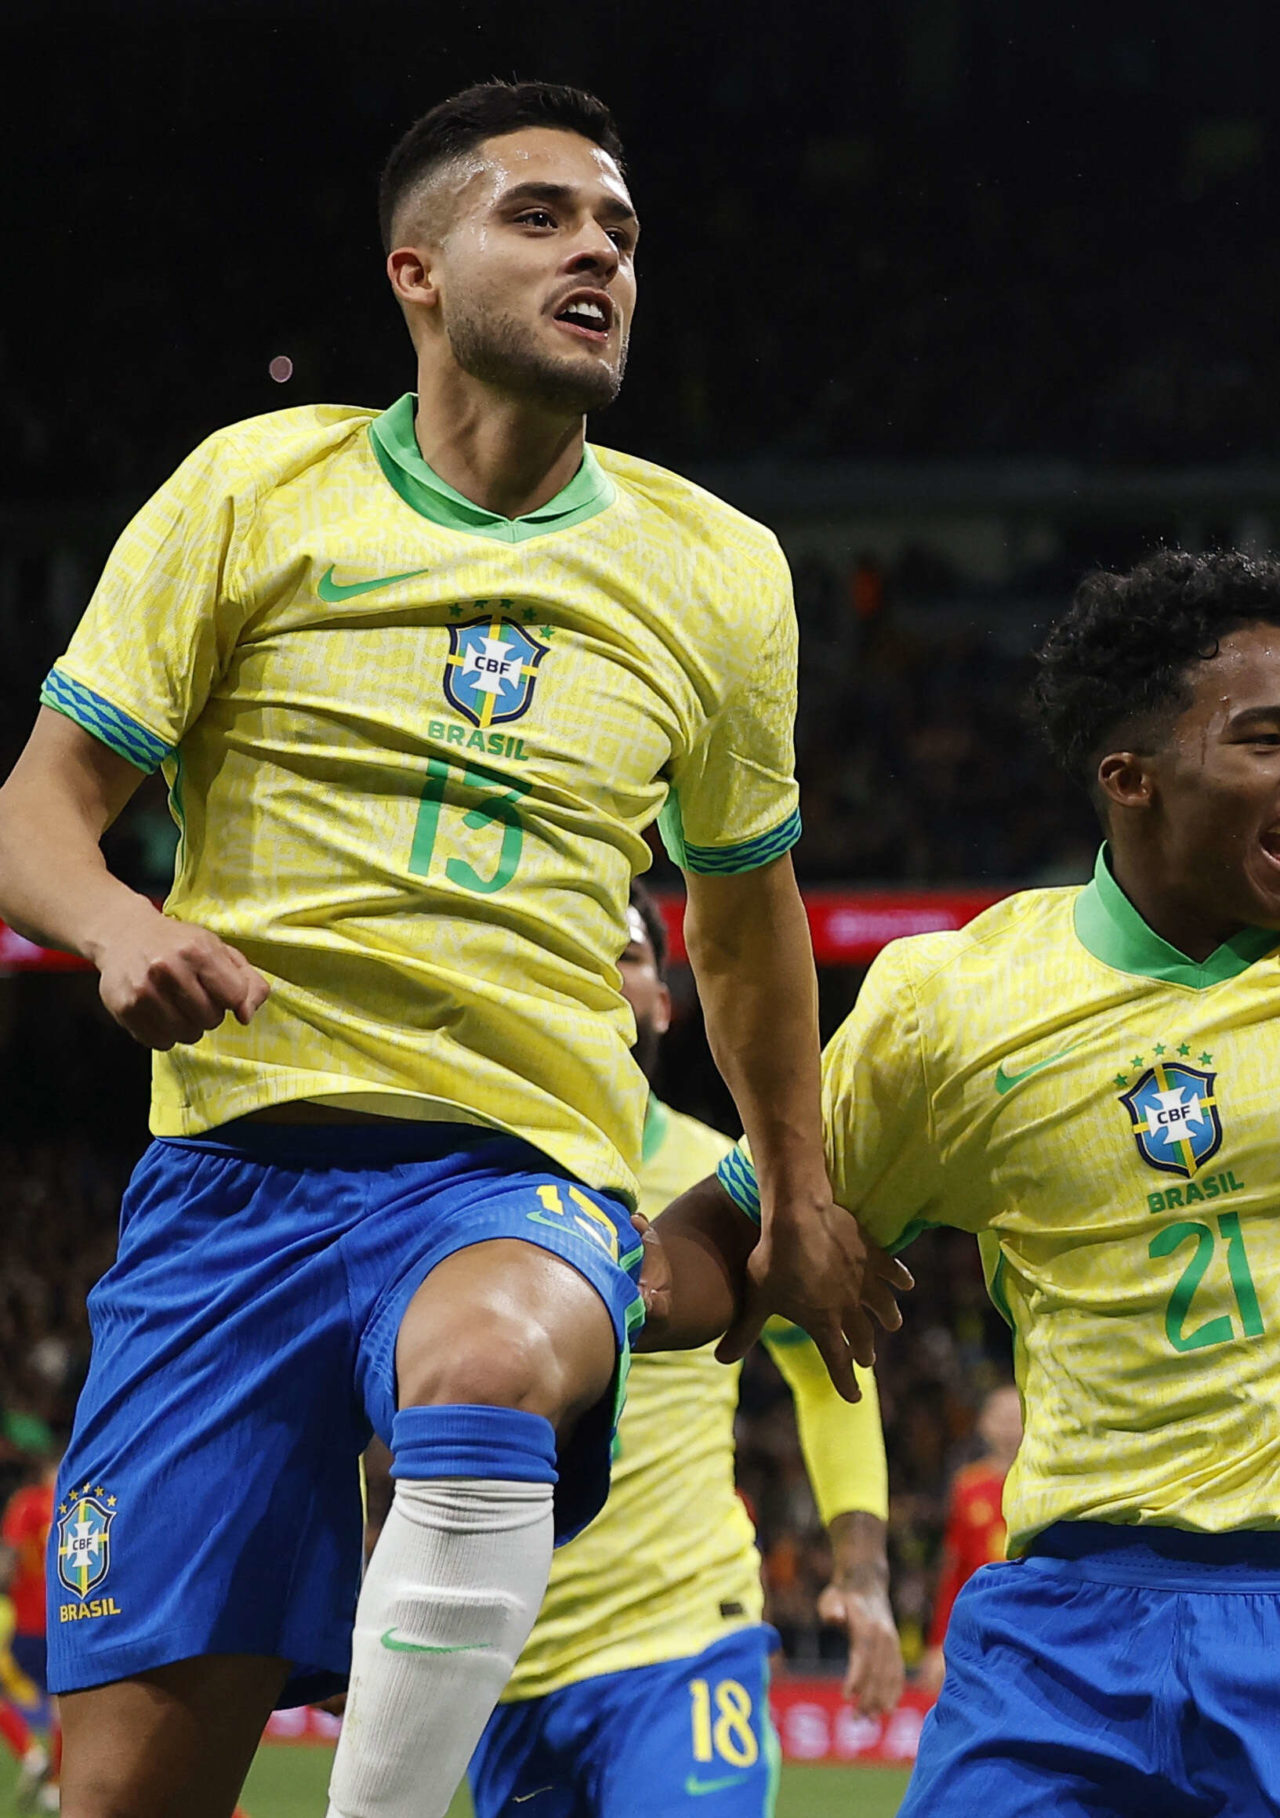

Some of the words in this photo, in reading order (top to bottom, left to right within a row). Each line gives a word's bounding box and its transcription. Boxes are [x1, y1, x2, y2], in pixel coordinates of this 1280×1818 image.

[474, 656, 512, 676] CBF
[428, 720, 530, 762] BRASIL
[408, 757, 533, 895] 13
[1156, 1105, 1191, 1125] CBF
[1147, 1171, 1245, 1214] BRASIL
[1148, 1211, 1266, 1353] 21
[72, 1538, 93, 1551] CBF
[59, 1598, 122, 1623] BRASIL
[689, 1678, 759, 1768] 18
